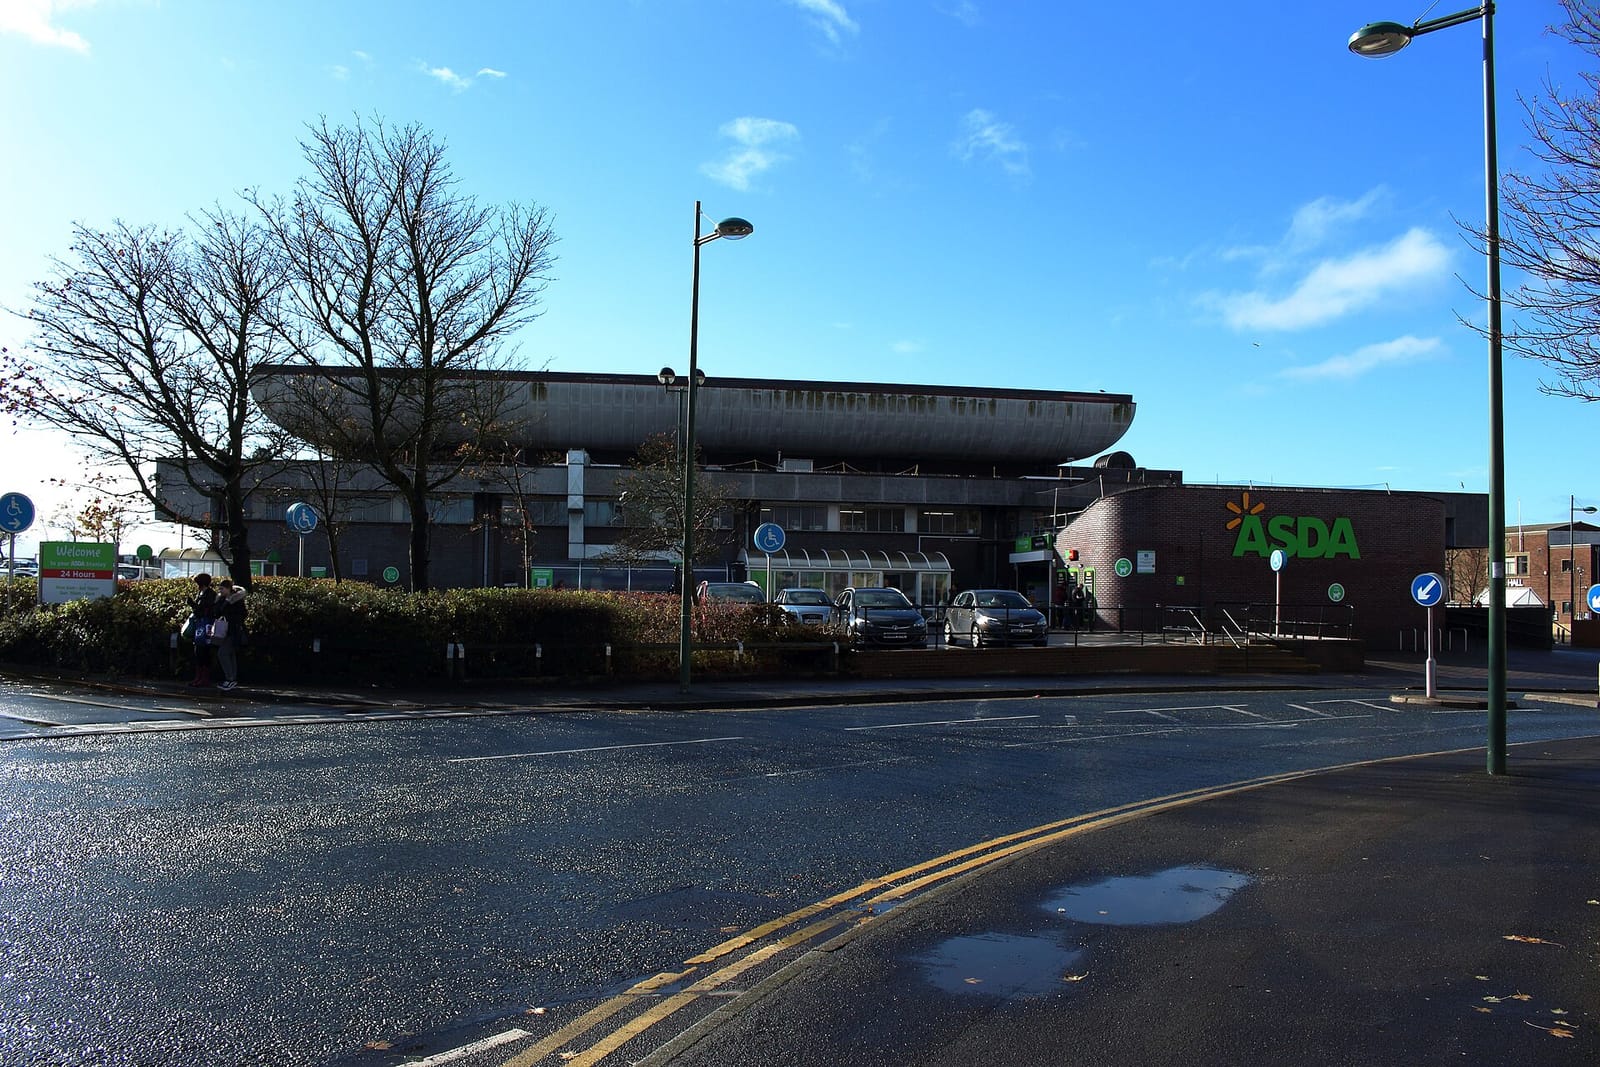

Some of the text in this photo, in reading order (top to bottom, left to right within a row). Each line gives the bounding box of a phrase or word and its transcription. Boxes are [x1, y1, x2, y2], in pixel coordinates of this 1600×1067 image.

[1233, 515, 1361, 559] ASDA
[56, 545, 101, 558] Welcome
[73, 570, 96, 578] Hours
[1507, 579, 1524, 587] HALL
